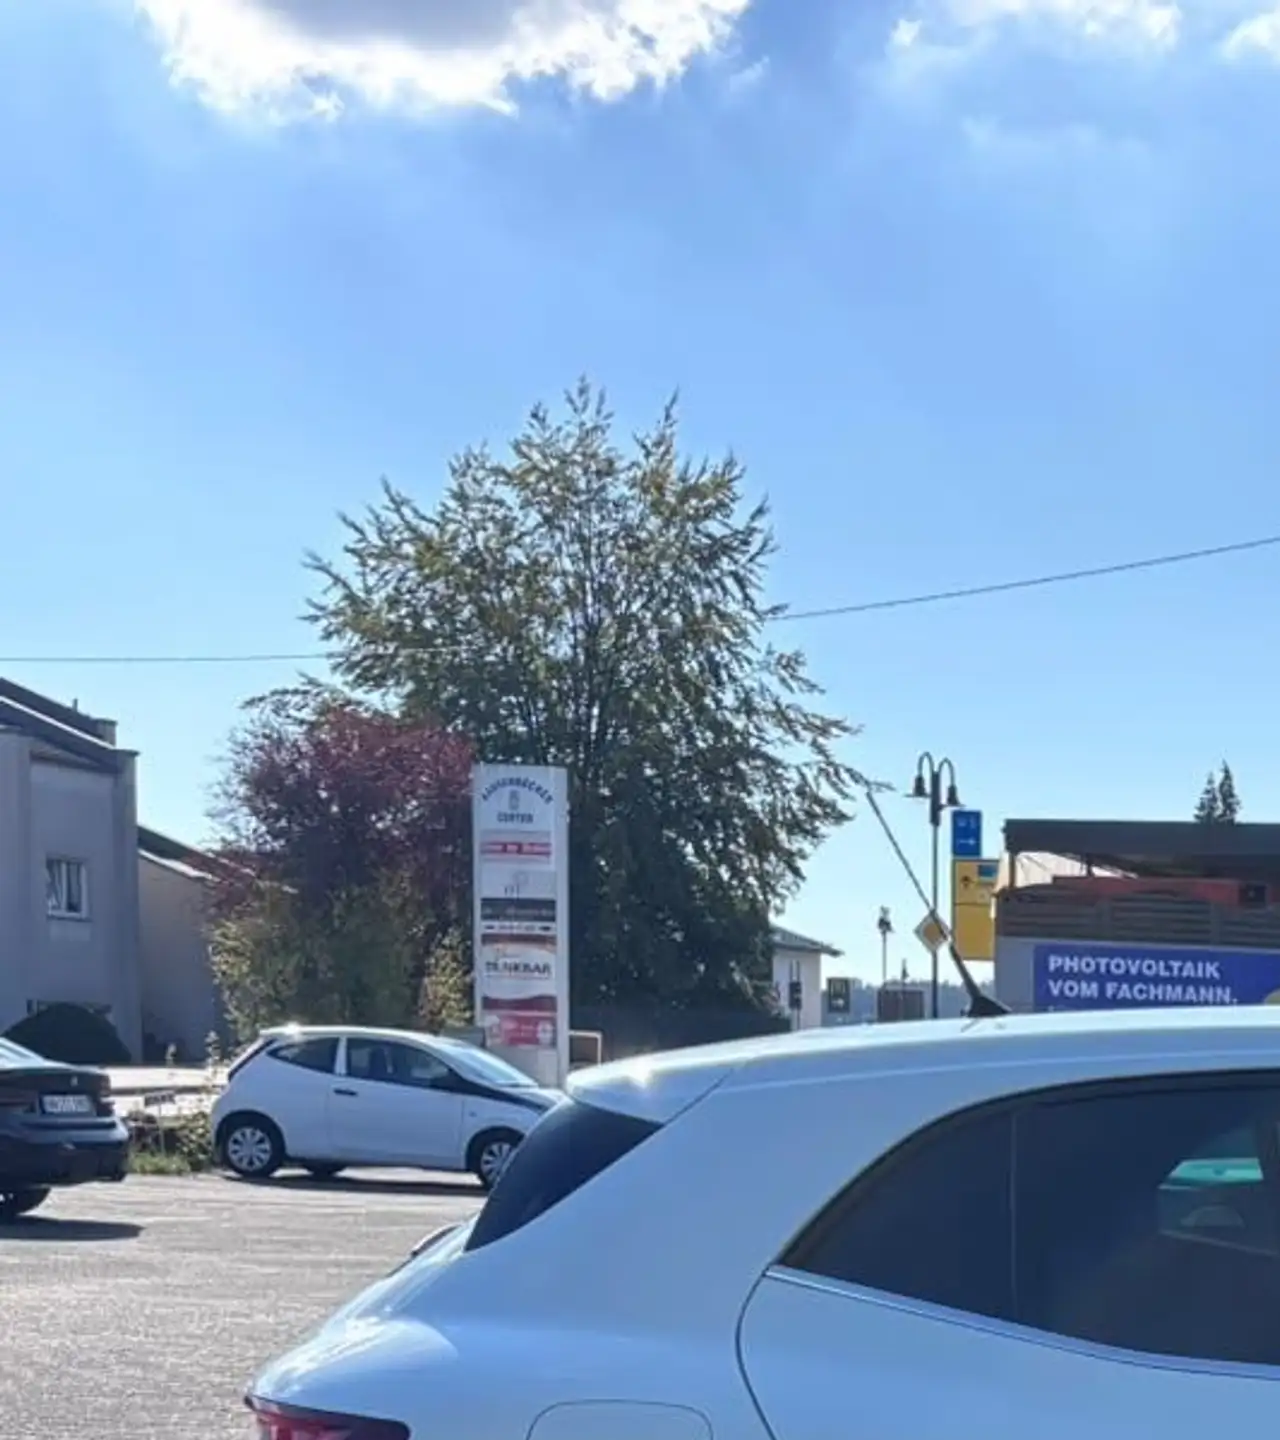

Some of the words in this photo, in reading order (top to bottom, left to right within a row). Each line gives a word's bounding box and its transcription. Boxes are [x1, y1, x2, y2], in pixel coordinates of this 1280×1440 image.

[1048, 955, 1220, 980] PHOTOVOLTAIK
[1048, 979, 1099, 998] VOM
[1106, 981, 1238, 1004] FACHMANN.
